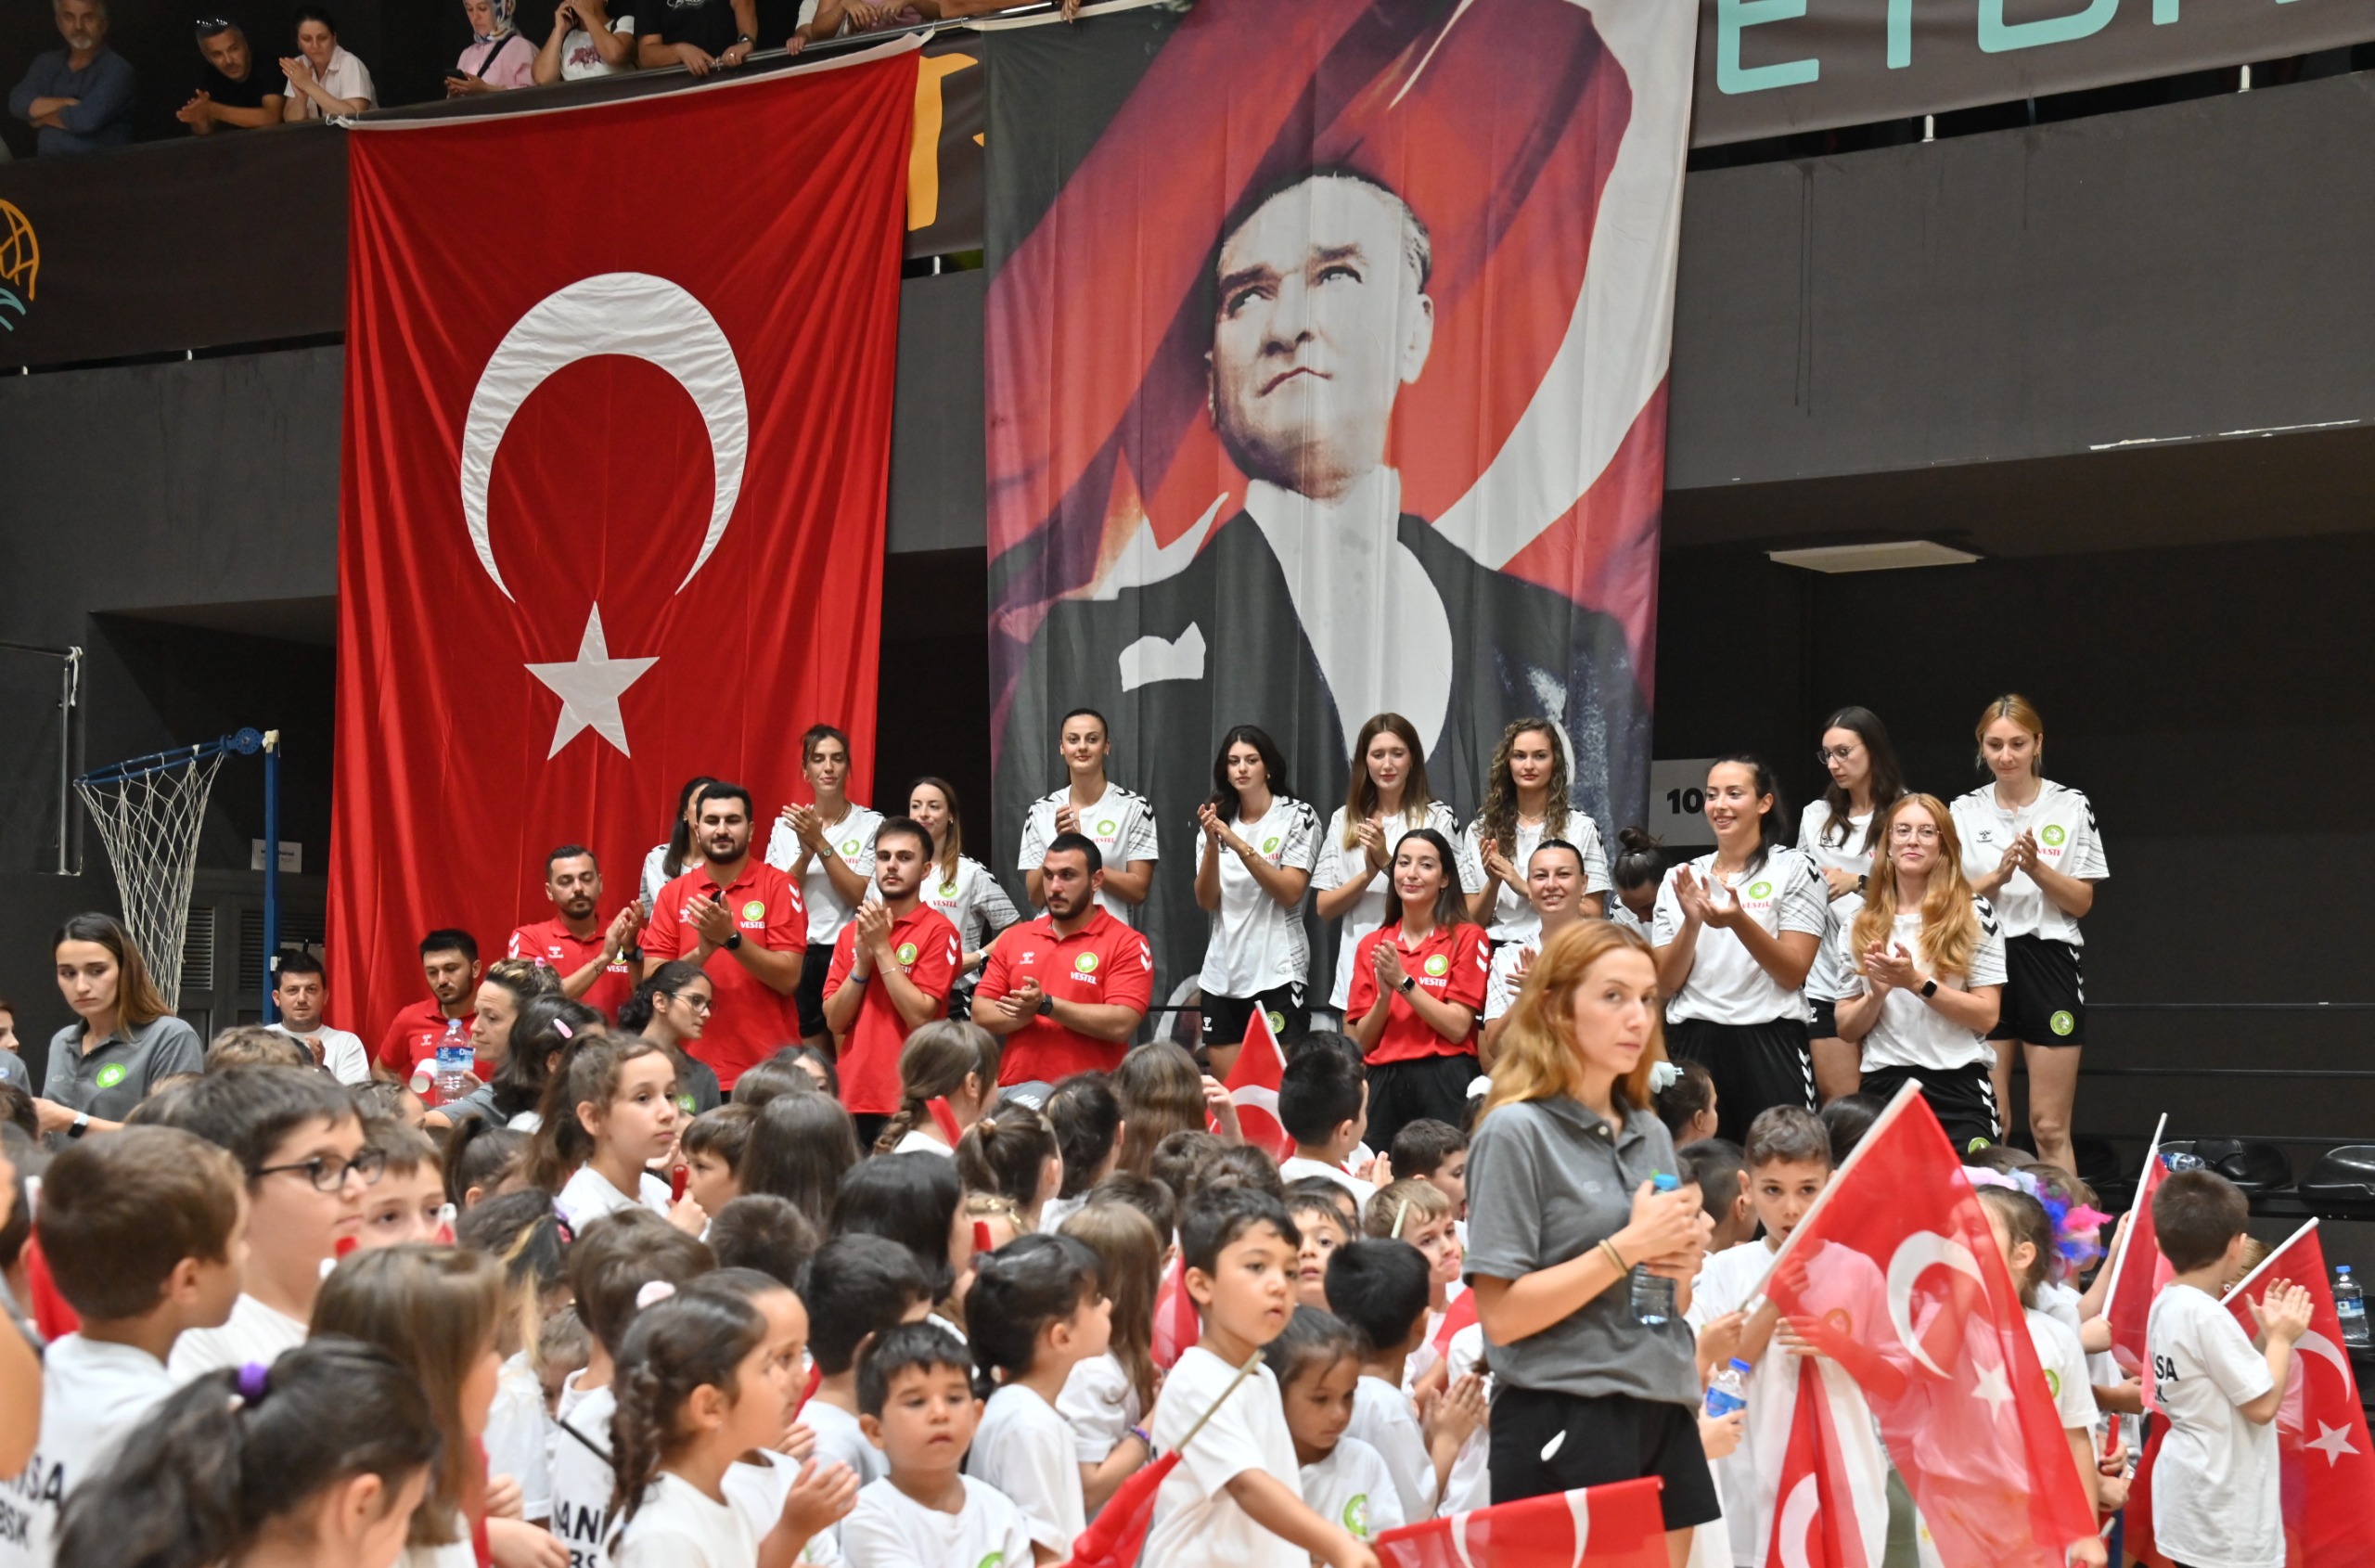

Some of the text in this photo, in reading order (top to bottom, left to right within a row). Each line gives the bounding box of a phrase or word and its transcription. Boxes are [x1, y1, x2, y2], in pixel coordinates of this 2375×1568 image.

[933, 900, 958, 908] VESTEL
[607, 965, 629, 973] VESTE
[1070, 971, 1098, 985] VESTEL
